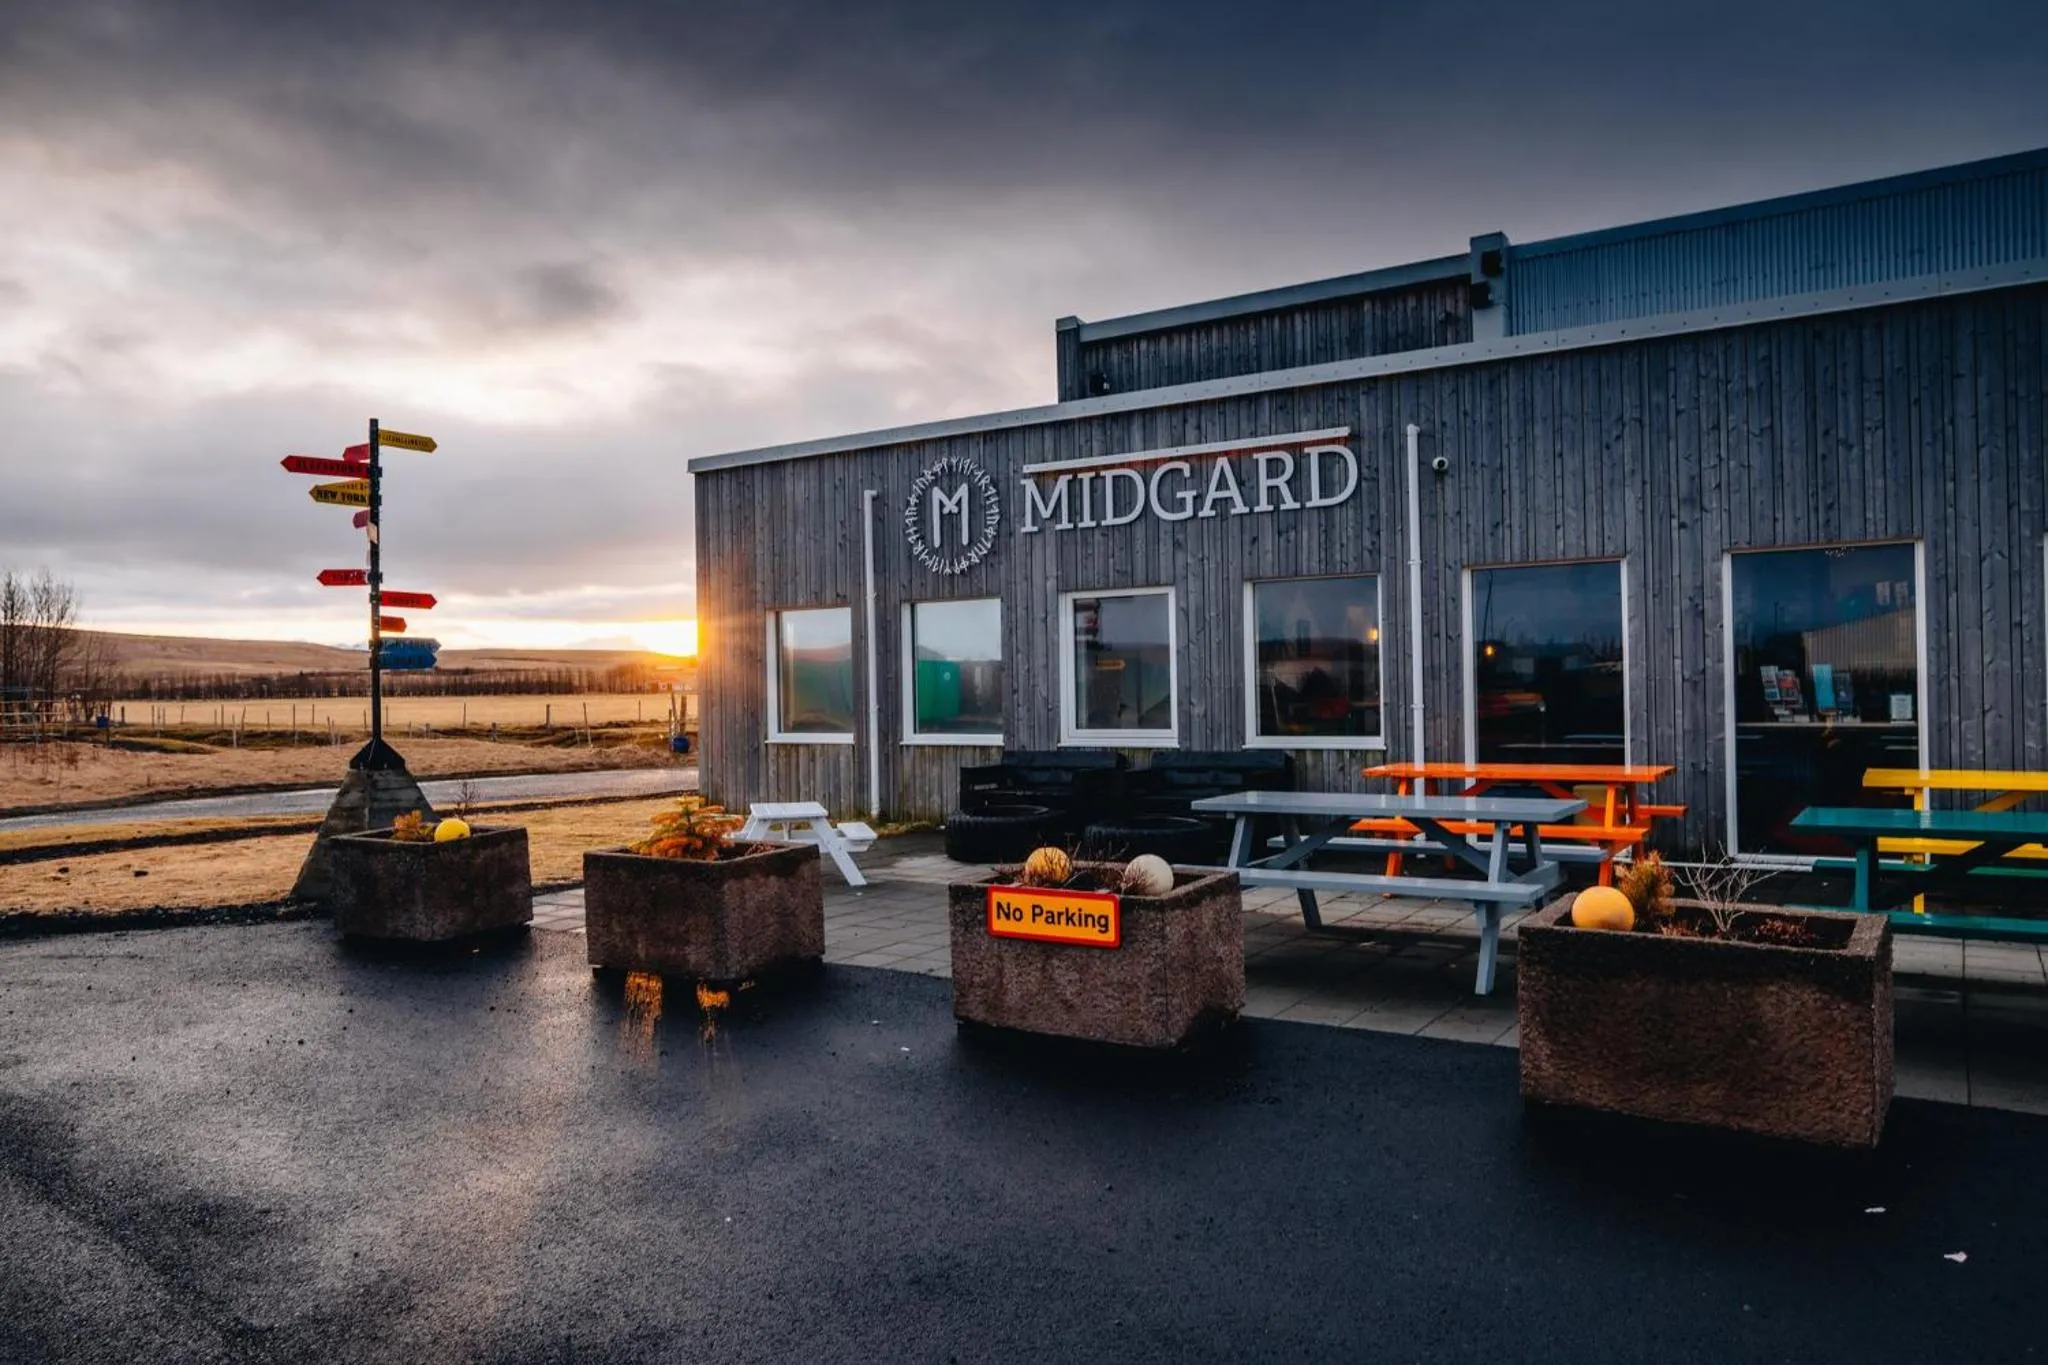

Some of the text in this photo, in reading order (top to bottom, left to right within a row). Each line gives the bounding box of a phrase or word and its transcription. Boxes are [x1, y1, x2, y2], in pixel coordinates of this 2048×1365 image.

[316, 488, 367, 503] NEW YORK
[1020, 444, 1358, 533] MIDGARD
[996, 901, 1110, 934] No Parking
